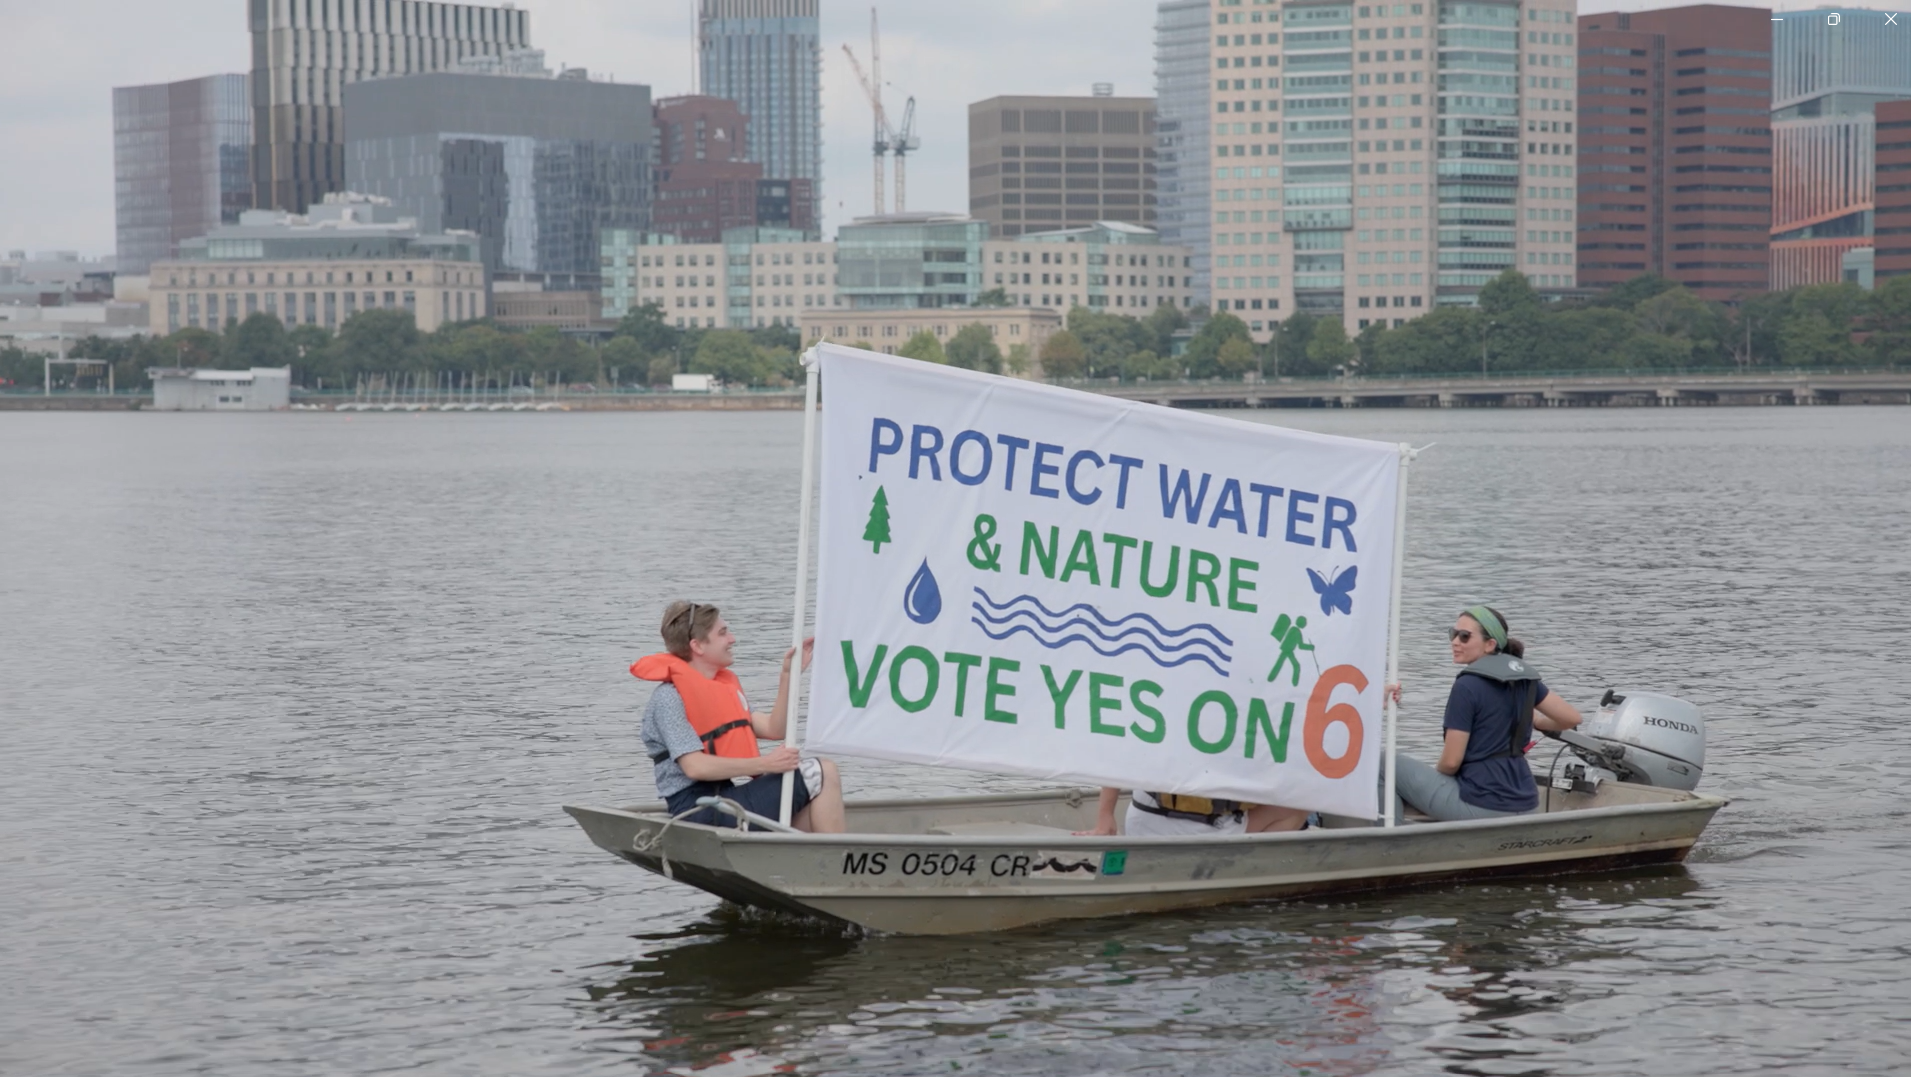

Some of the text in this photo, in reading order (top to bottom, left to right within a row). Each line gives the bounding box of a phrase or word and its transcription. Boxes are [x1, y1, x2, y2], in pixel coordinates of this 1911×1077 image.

[869, 417, 1357, 552] PROTECT WATER
[967, 514, 1259, 613] & NATURE
[841, 641, 1369, 779] VOTE YES ON 6
[1643, 716, 1699, 735] HONDA
[842, 852, 1030, 877] MS 0504 CR
[1498, 836, 1577, 851] STARCRAFT
